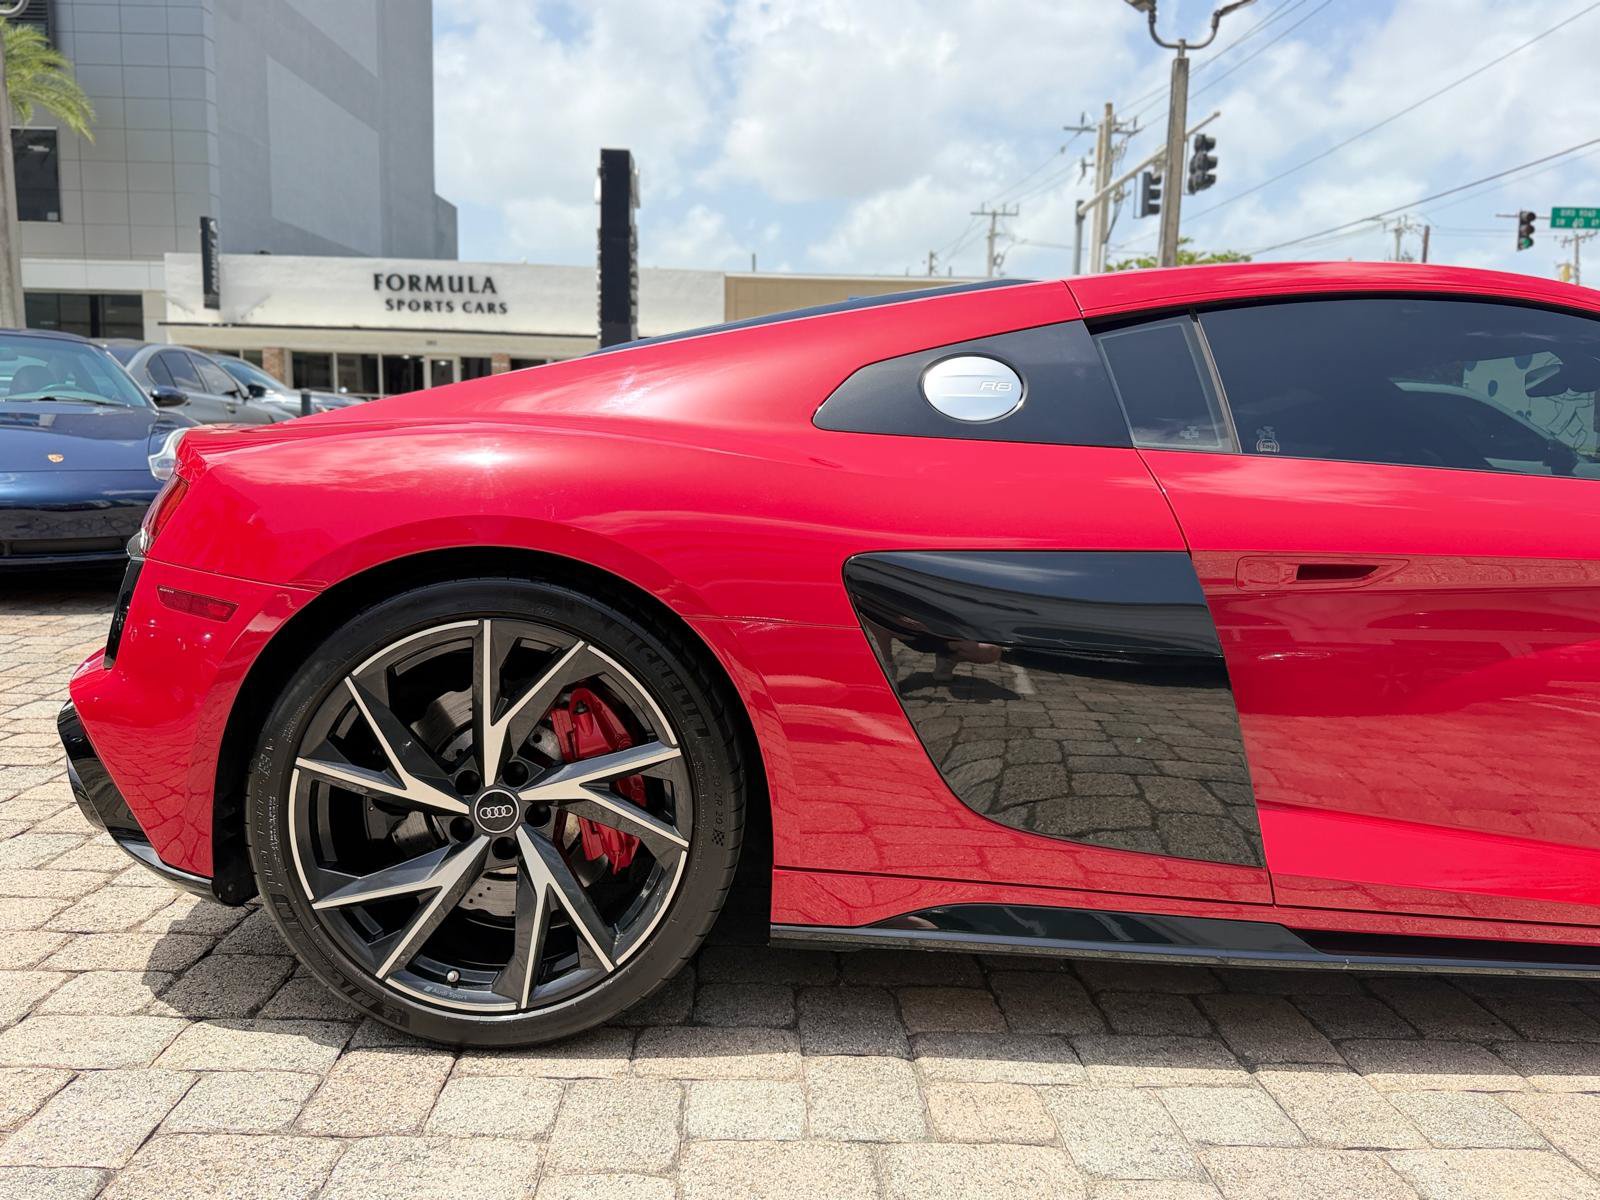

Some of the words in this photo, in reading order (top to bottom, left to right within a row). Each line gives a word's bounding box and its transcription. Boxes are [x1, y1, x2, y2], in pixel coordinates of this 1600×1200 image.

[373, 273, 498, 294] FORMULA
[385, 298, 454, 313] SPORTS
[462, 301, 508, 315] CARS
[980, 380, 1013, 392] R8
